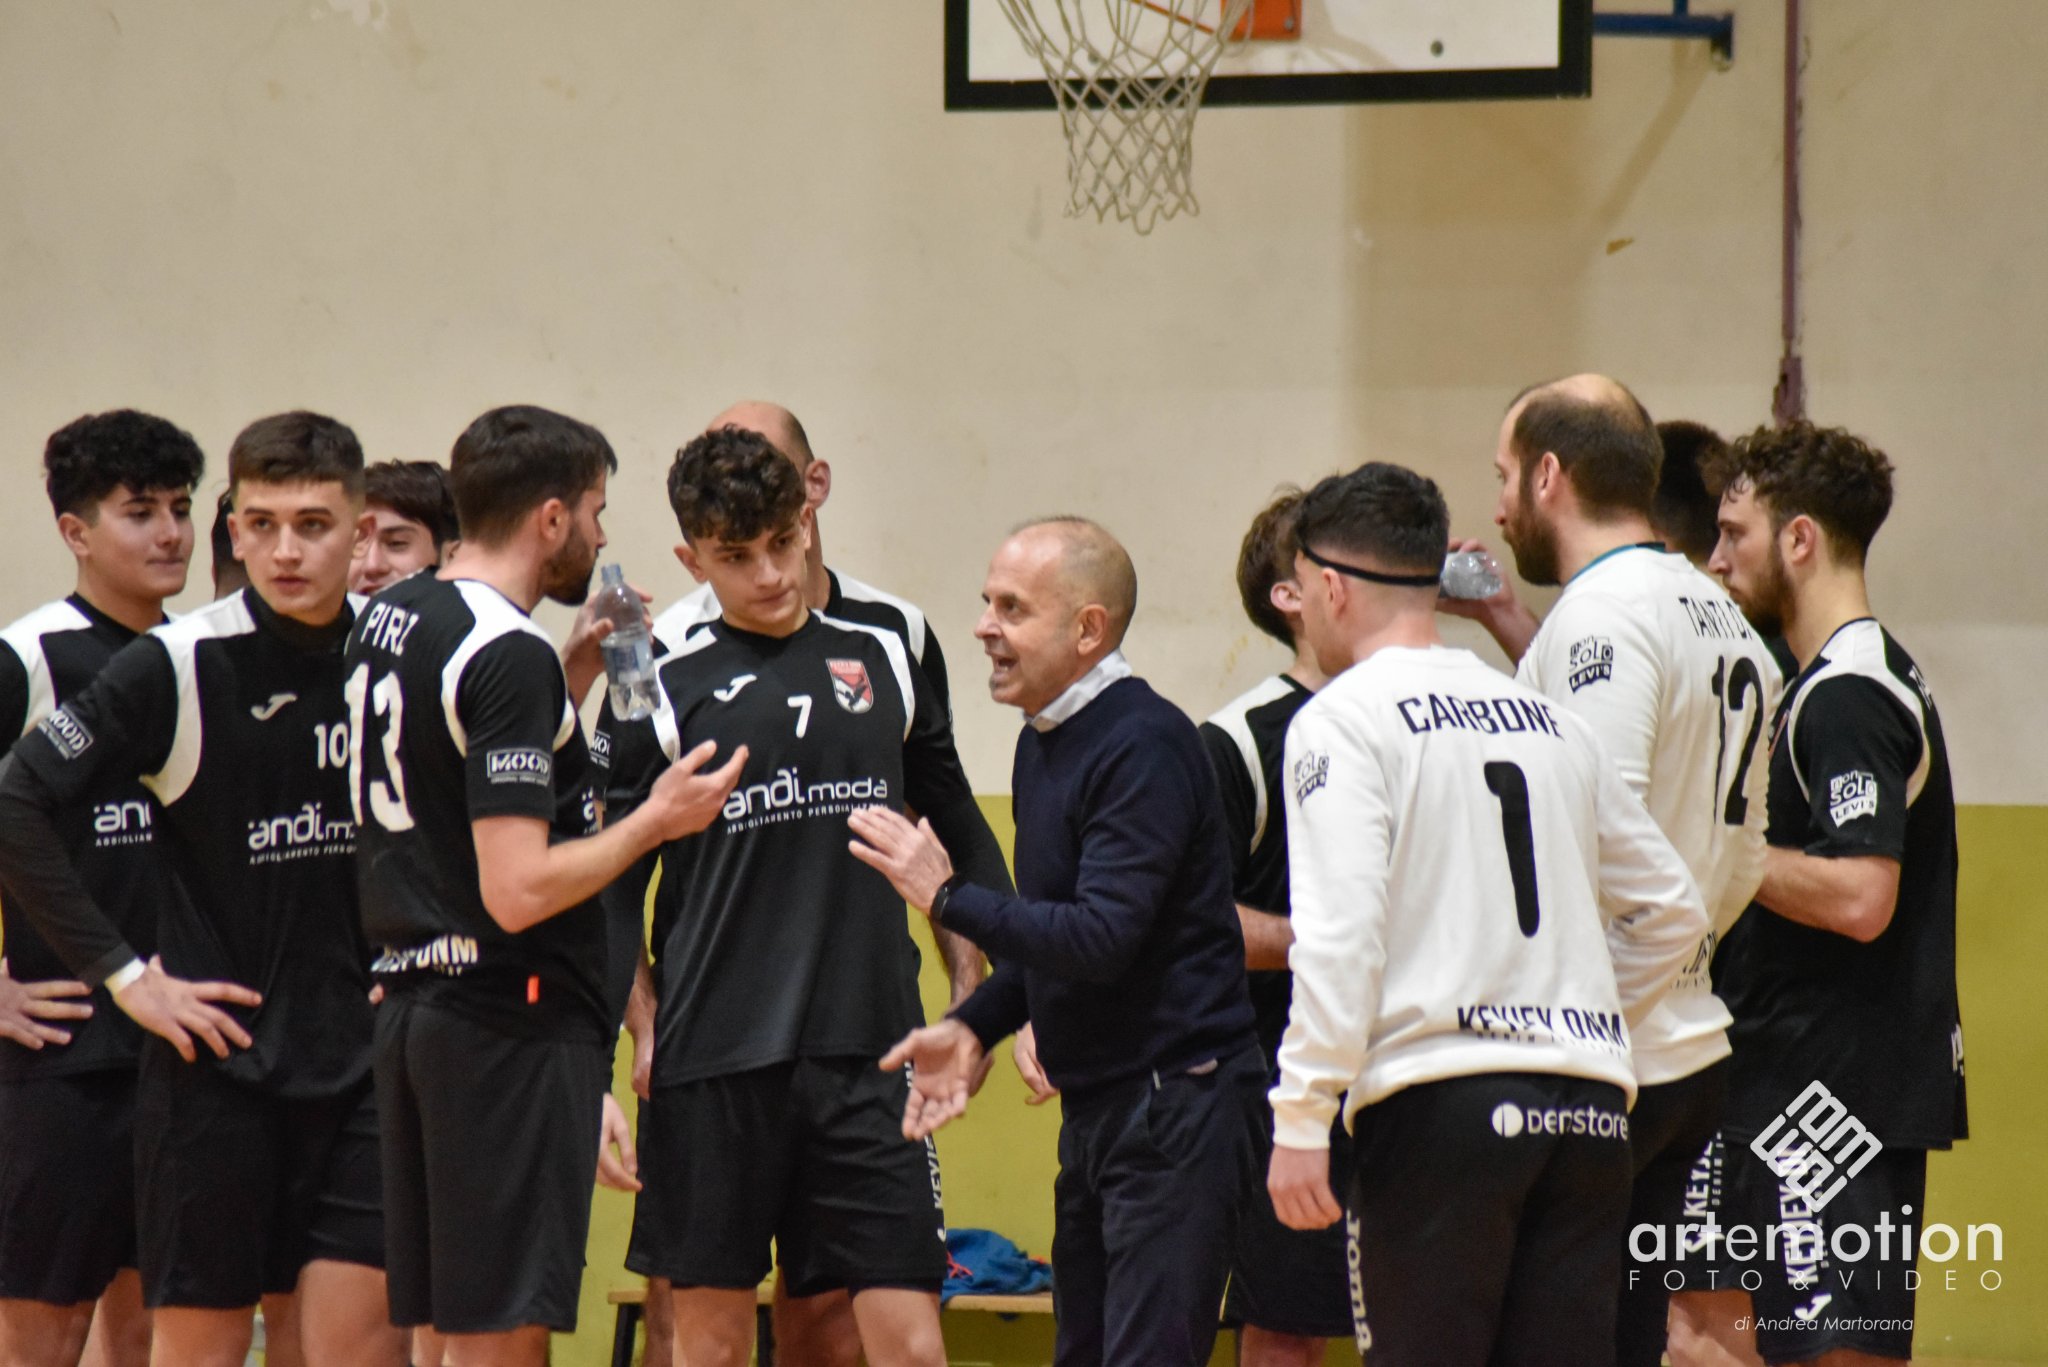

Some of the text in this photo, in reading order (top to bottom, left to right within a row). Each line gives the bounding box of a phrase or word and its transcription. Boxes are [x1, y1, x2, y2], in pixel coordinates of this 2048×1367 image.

[787, 694, 813, 739] 7
[1396, 693, 1566, 742] CARBONE
[1711, 654, 1765, 827] 12
[314, 722, 349, 770] 10
[344, 662, 415, 833] 13
[722, 766, 806, 821] andi
[247, 801, 325, 851] andi
[1483, 760, 1541, 939] 1
